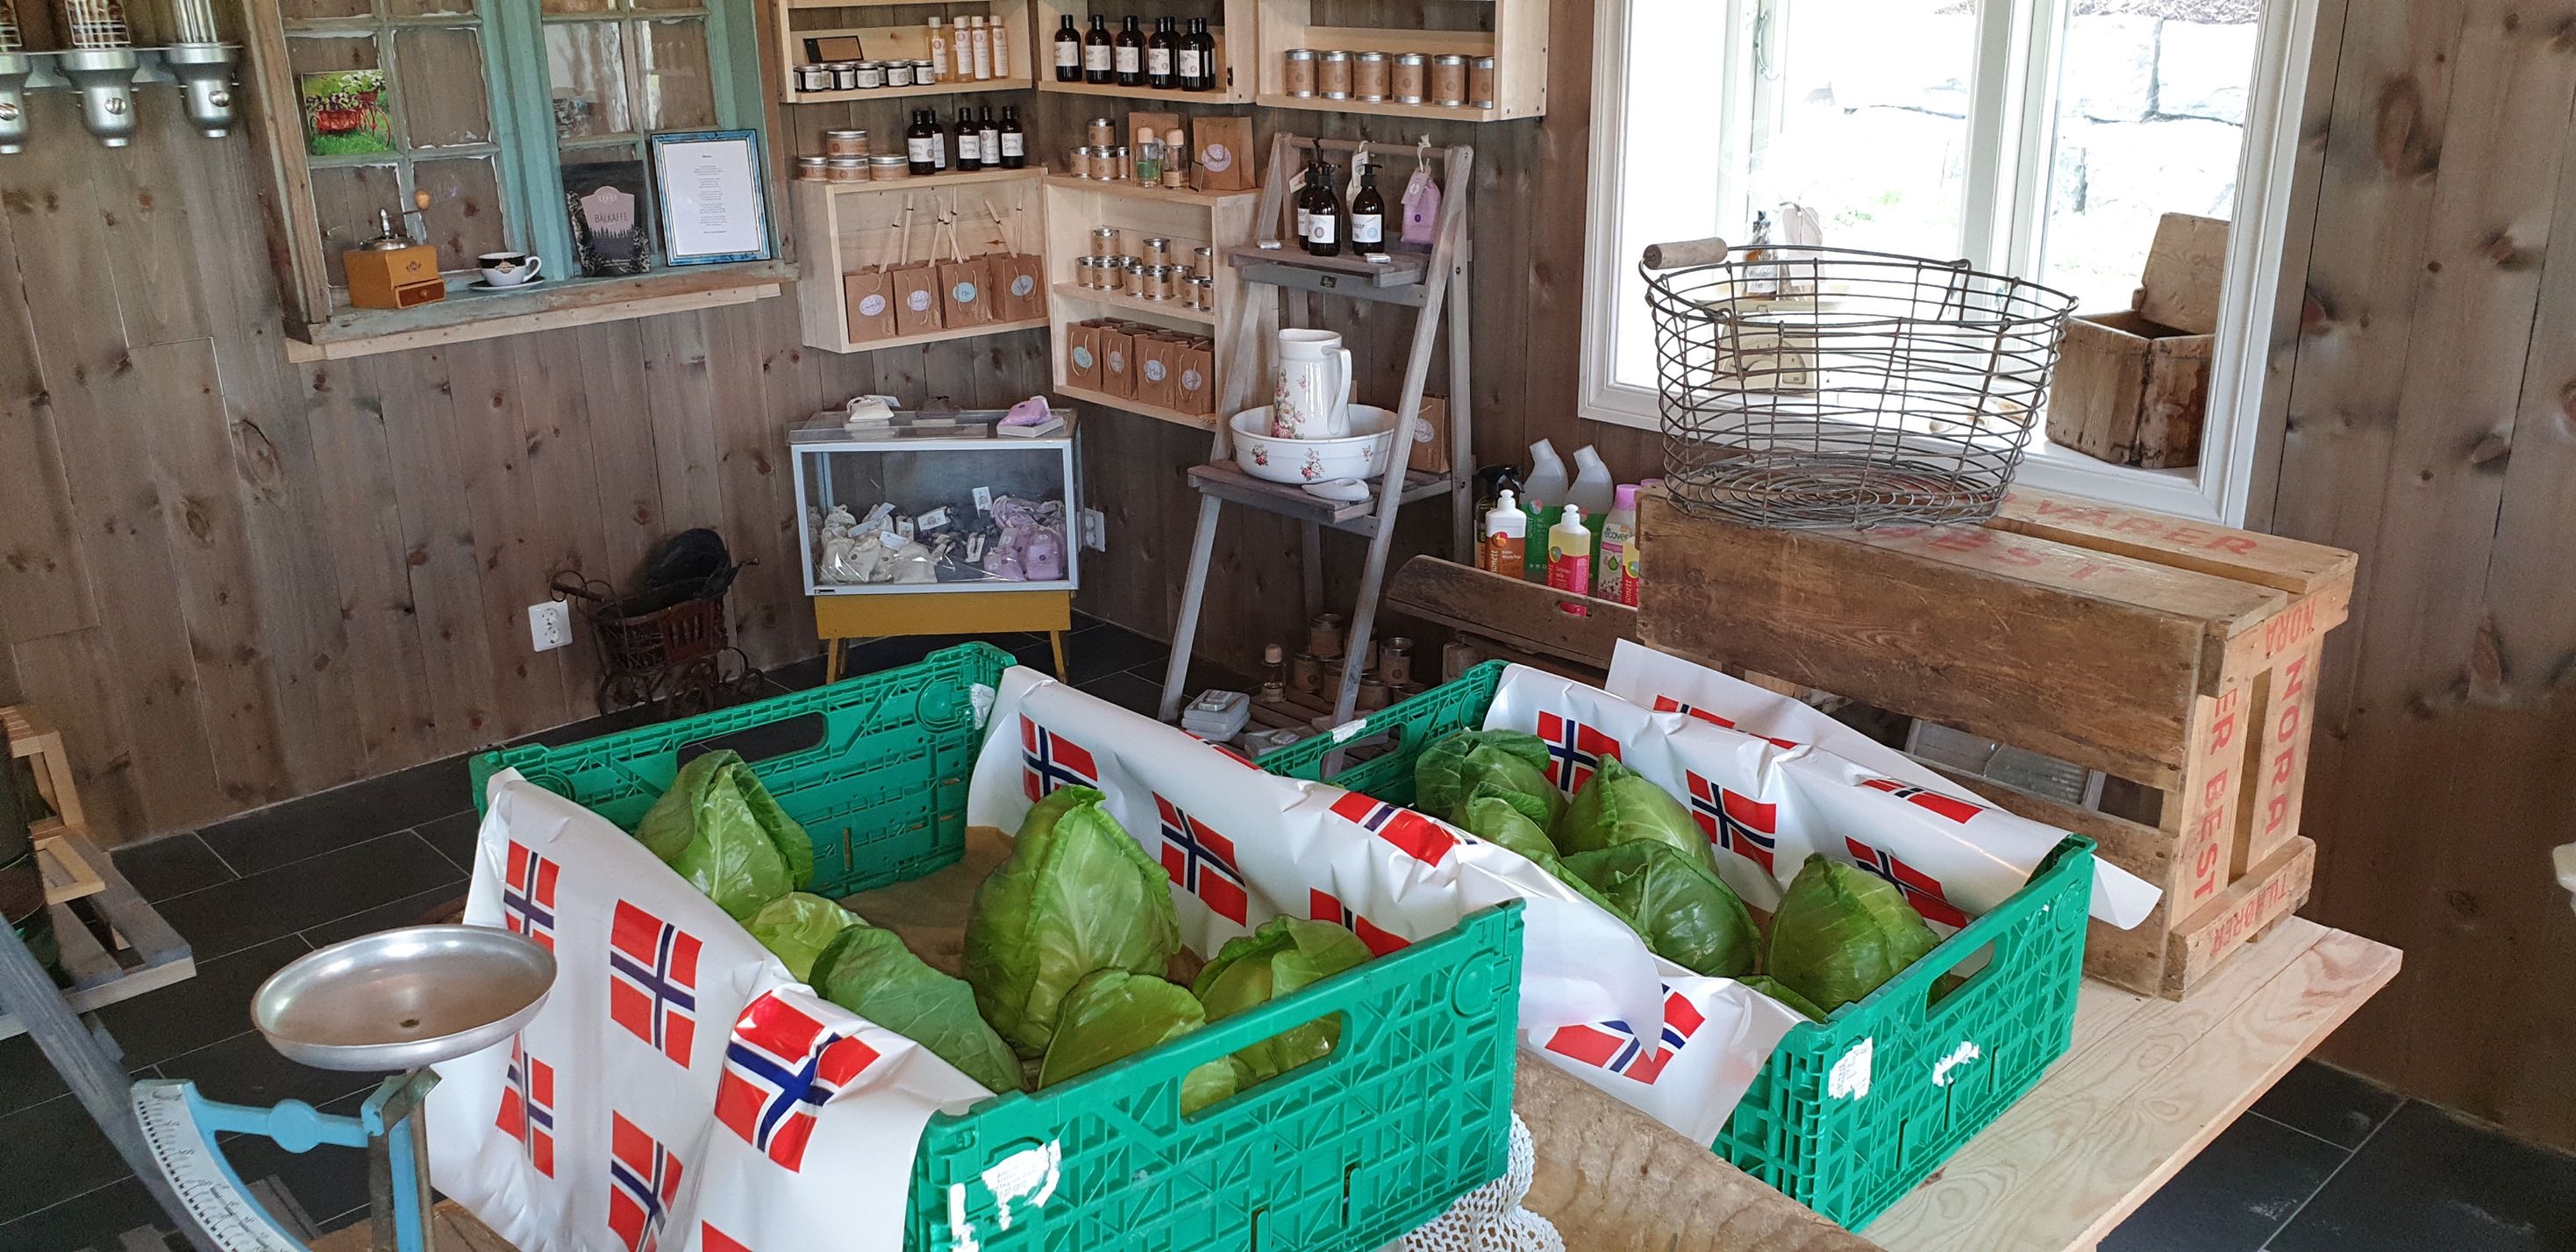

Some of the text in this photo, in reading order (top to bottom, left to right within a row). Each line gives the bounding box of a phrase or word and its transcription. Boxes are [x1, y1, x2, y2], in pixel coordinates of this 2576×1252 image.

[2194, 688, 2237, 899] ER BEST
[2266, 654, 2307, 835] NORA
